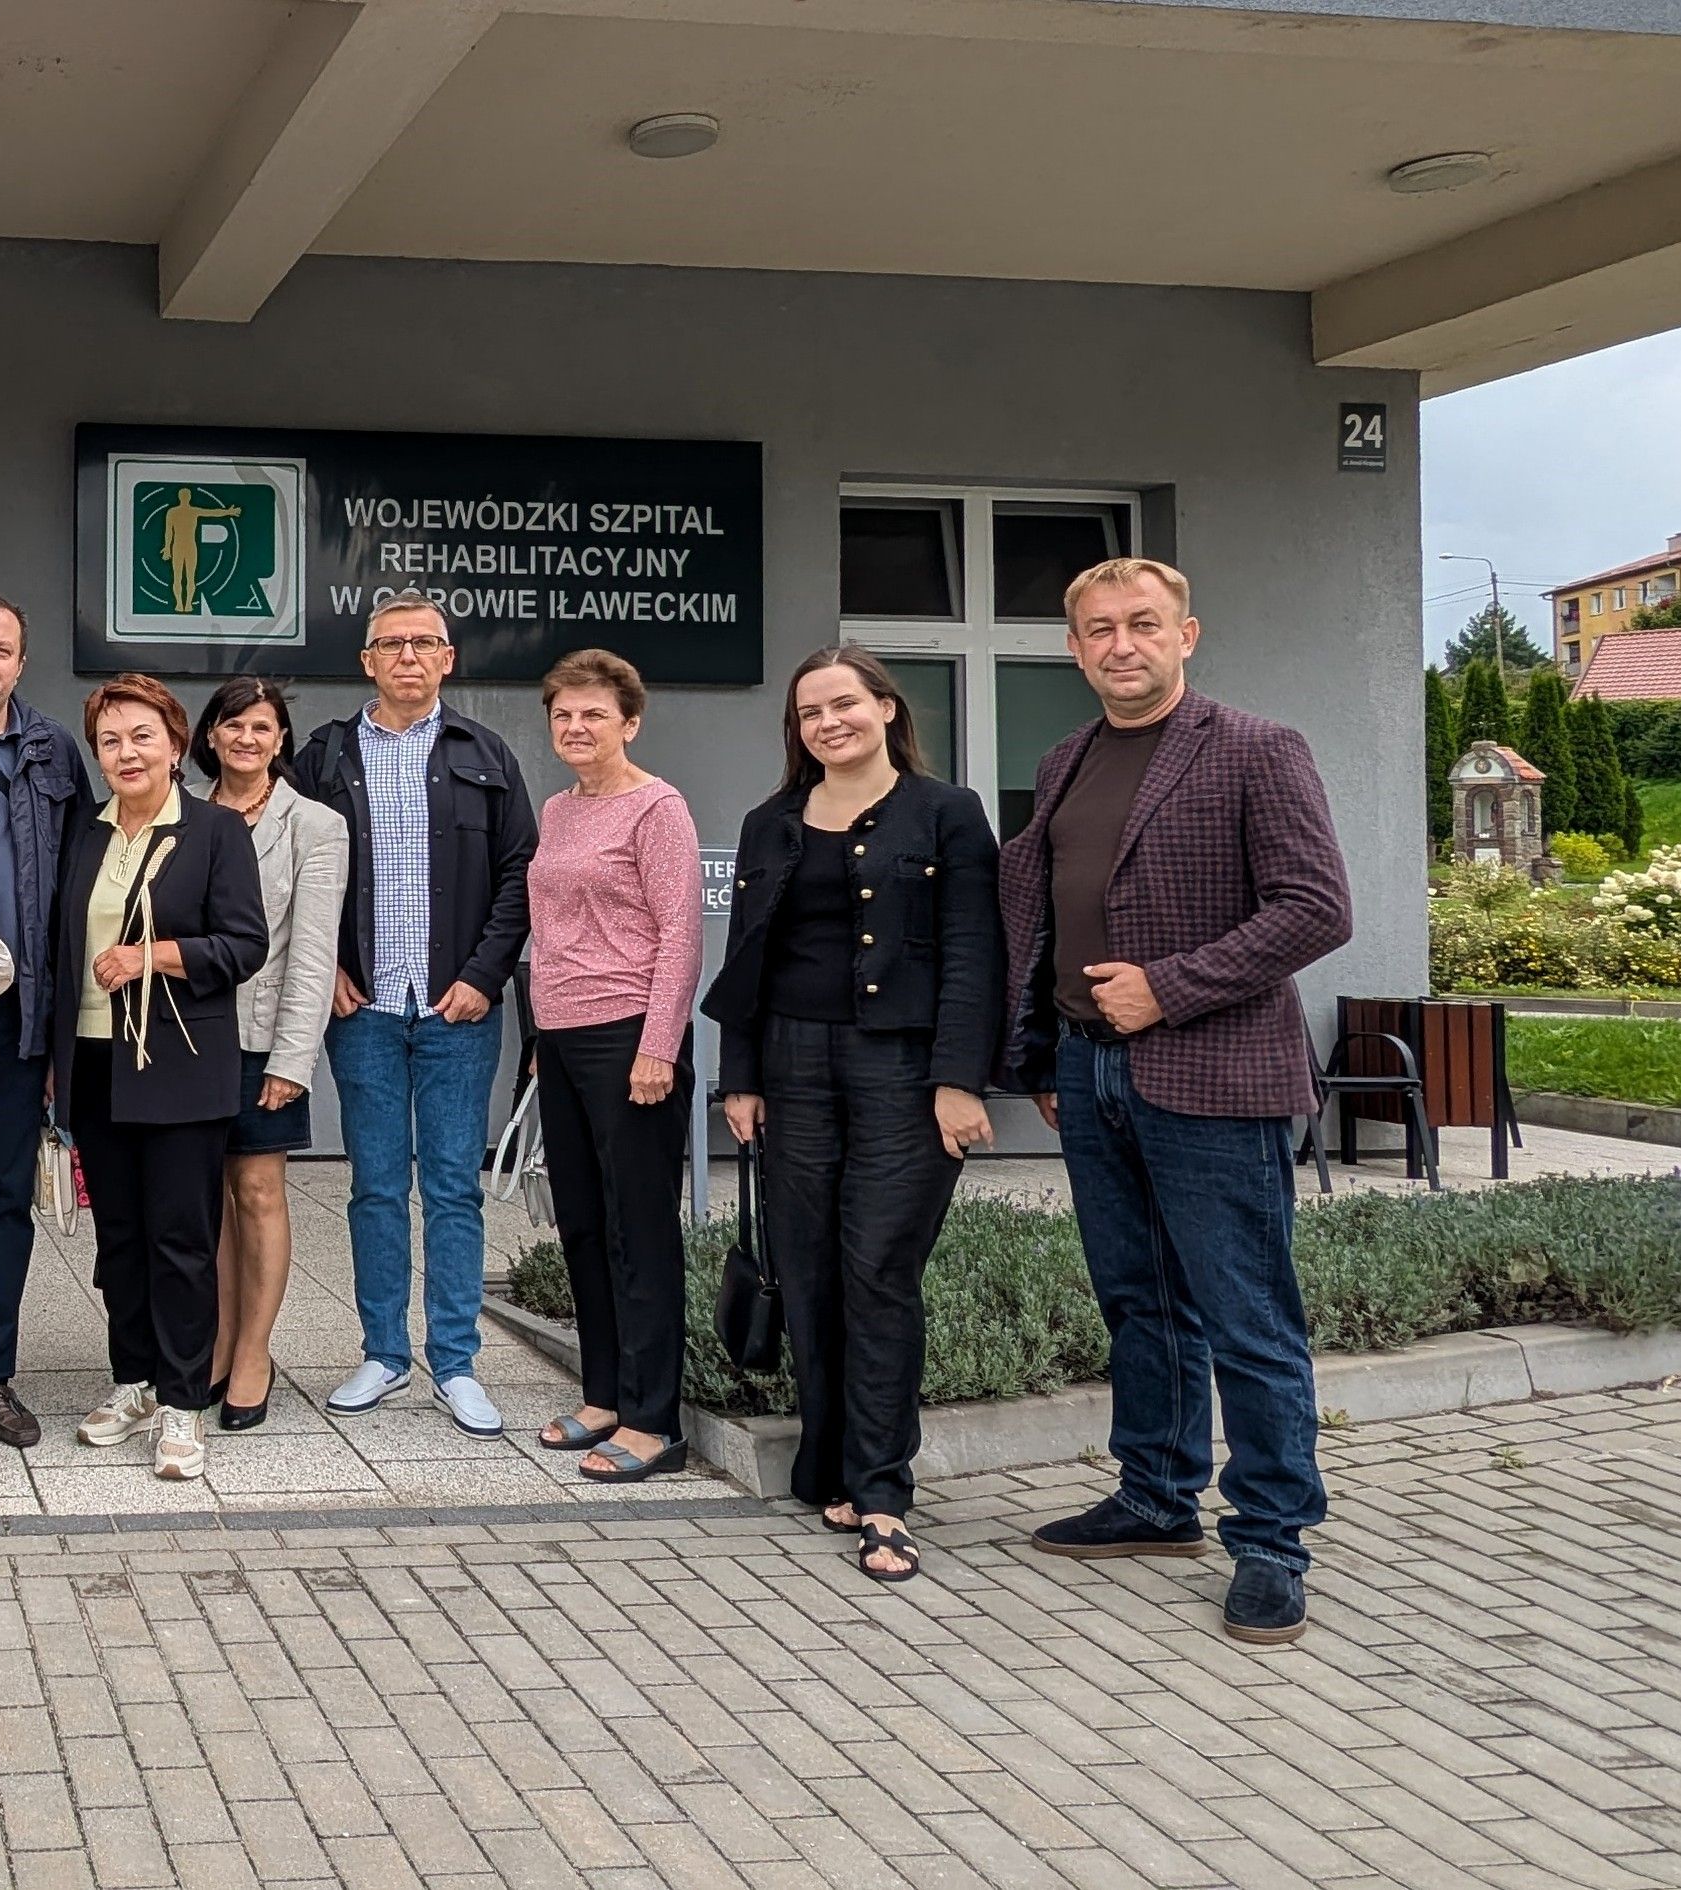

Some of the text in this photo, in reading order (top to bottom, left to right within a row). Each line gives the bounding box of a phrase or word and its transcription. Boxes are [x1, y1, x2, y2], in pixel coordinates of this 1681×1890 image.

[1344, 413, 1384, 449] 24
[344, 493, 725, 535] WOJEWÓDZKI SZPITAL
[380, 543, 691, 578] REHABILITACYJNY
[330, 585, 362, 615] W
[549, 589, 737, 623] IŁAWECKIM
